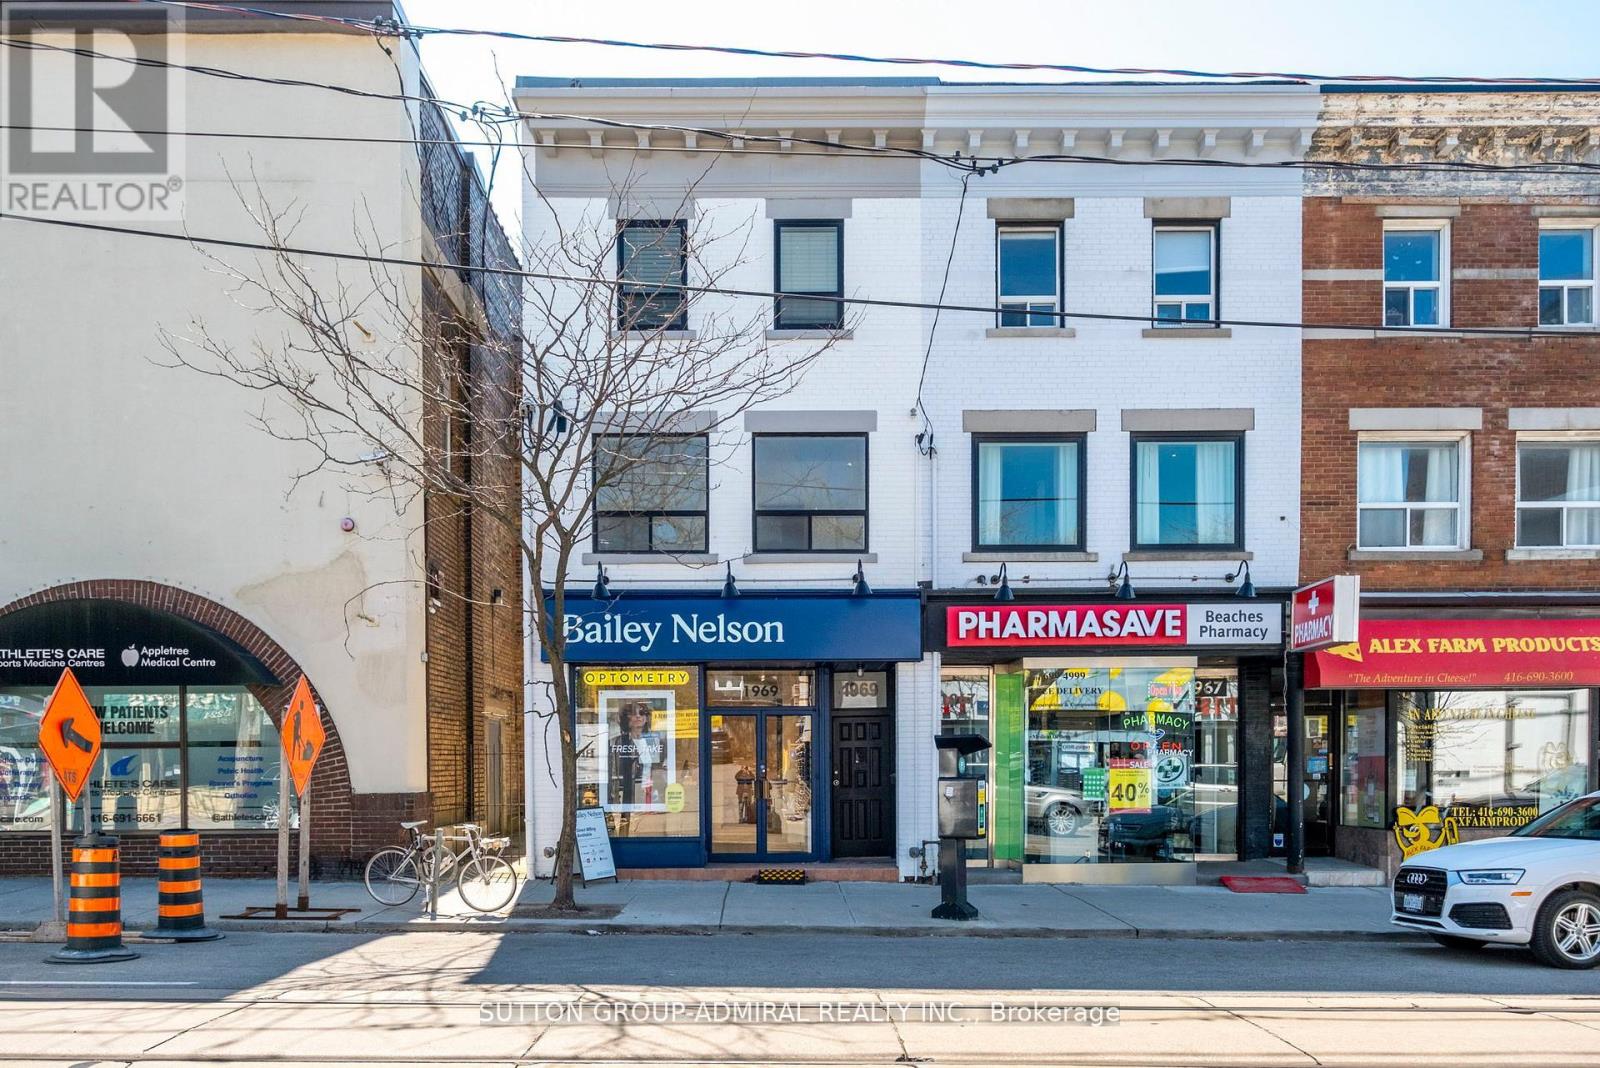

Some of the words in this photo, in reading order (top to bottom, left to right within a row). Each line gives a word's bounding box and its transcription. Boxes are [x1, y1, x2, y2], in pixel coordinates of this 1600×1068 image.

[1205, 610, 1263, 623] Beaches
[958, 610, 1181, 638] PHARMASAVE
[1295, 614, 1333, 644] PHARMACY
[563, 613, 661, 652] Bailey
[672, 613, 784, 643] Nelson
[1199, 625, 1268, 641] Pharmacy
[1369, 638, 1423, 653] ALEX
[1427, 638, 1487, 652] FARM
[1493, 637, 1600, 652] PRODUCTS
[67, 649, 105, 659] CARE
[140, 646, 189, 657] Appletree
[141, 657, 180, 667] Medical
[183, 657, 216, 667] Centre
[585, 672, 688, 683] OPTOMETRY
[1373, 673, 1422, 683] Adventure
[1425, 674, 1434, 682] in
[1504, 671, 1573, 682] 416-690-3600
[744, 685, 778, 697] 1969
[1057, 687, 1103, 695] DELIVERY
[111, 706, 168, 719] PATIENTS
[101, 721, 155, 734] ELCOME
[1123, 714, 1190, 731] PHARMACY
[1147, 749, 1194, 758] PHARMACY
[1452, 807, 1476, 817] TEL:
[1477, 807, 1538, 818] 416-690-3600
